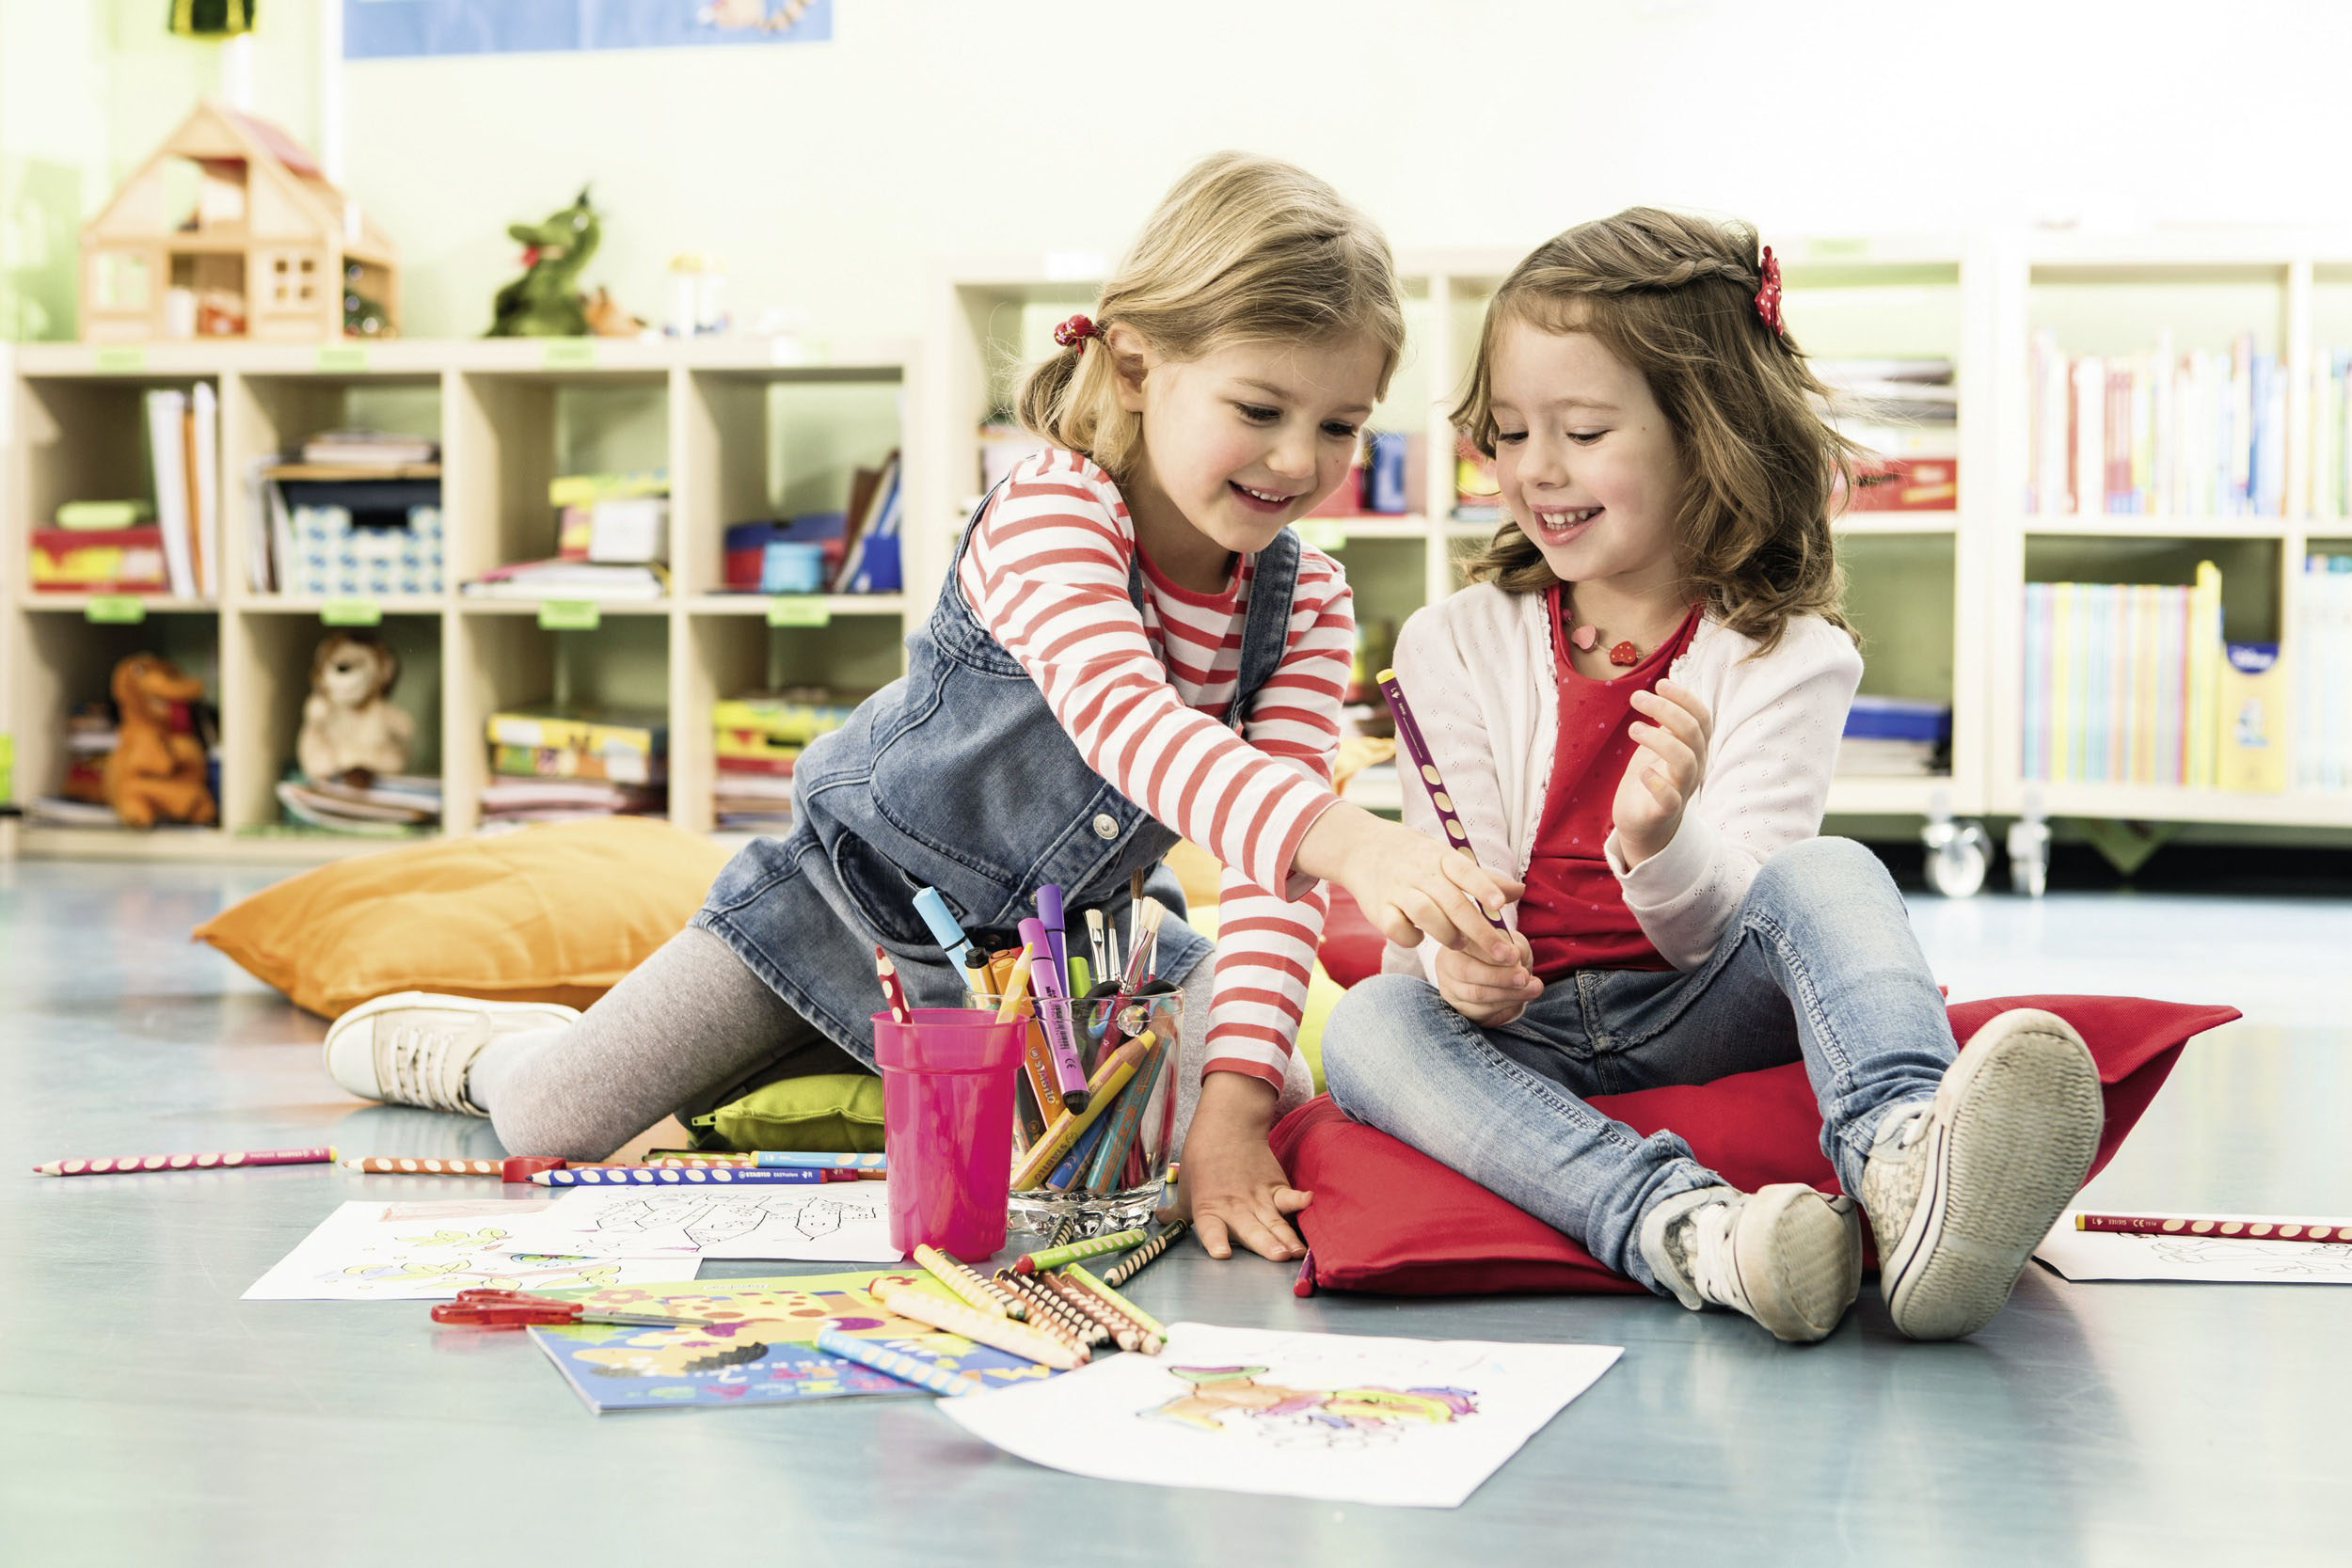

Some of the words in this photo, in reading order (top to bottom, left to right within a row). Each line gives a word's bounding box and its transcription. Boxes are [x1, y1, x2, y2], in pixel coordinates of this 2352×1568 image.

[1034, 1059, 1056, 1104] STABILO
[745, 1170, 771, 1179] STABILO
[1034, 1143, 1069, 1181] STABILO
